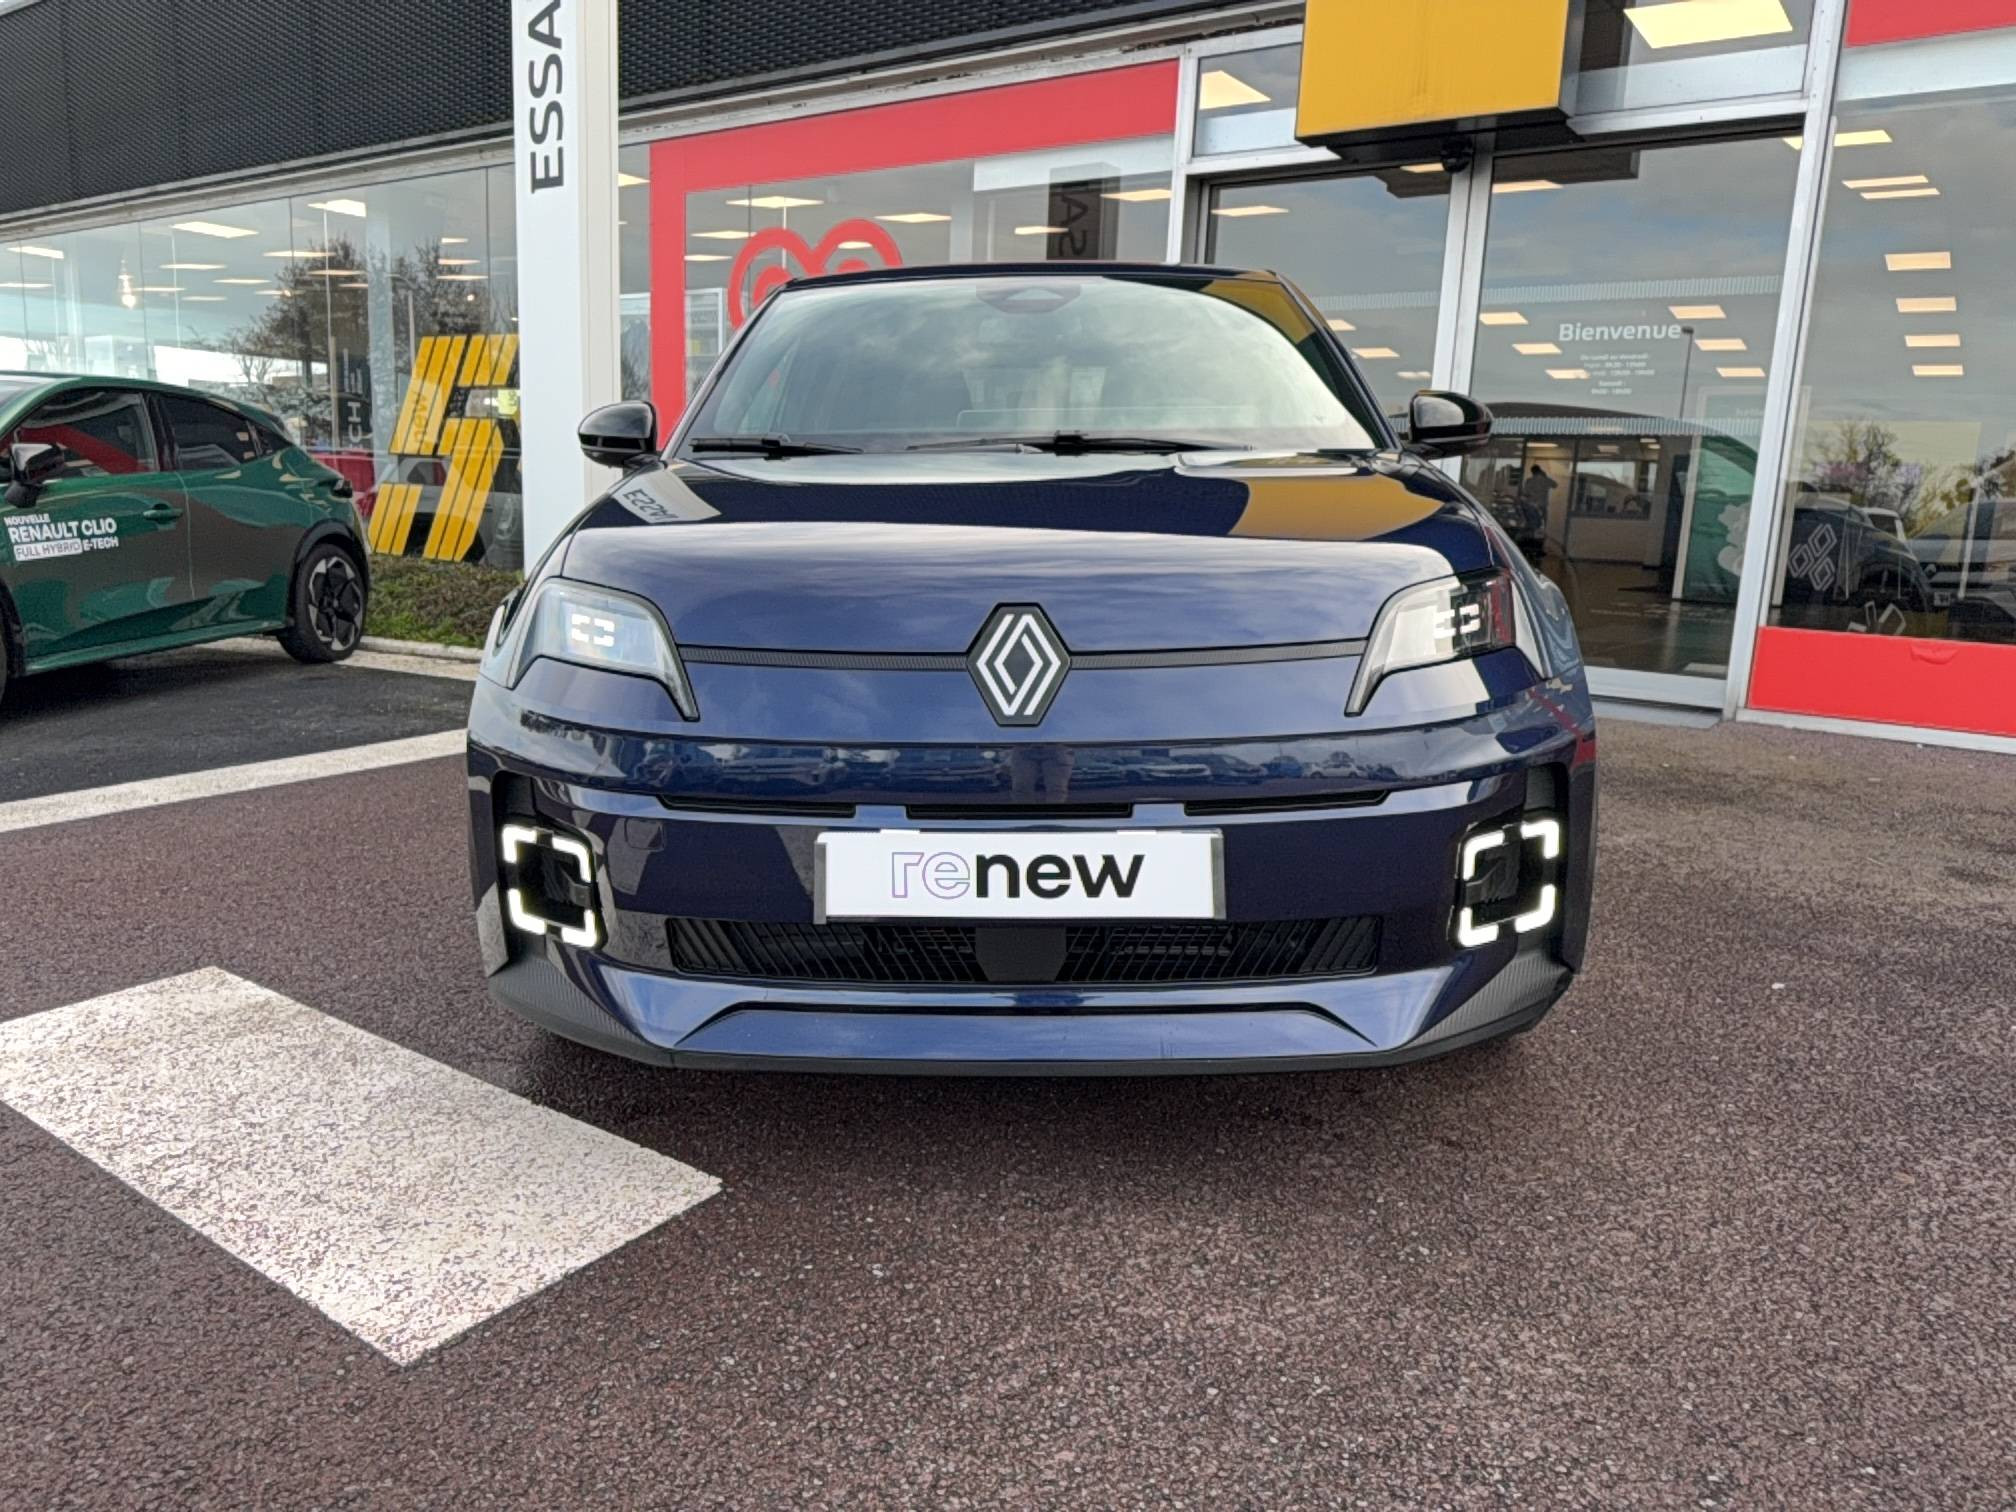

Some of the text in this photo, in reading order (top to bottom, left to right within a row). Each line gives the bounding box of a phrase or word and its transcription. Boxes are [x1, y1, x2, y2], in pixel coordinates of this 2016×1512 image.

[1559, 323, 1681, 341] Bienvenue
[4, 513, 50, 526] NOUVELLE
[8, 518, 117, 543] RENAULT CLIO
[16, 536, 119, 557] FULL HYBRID E-TECH
[892, 851, 1145, 900] renew
